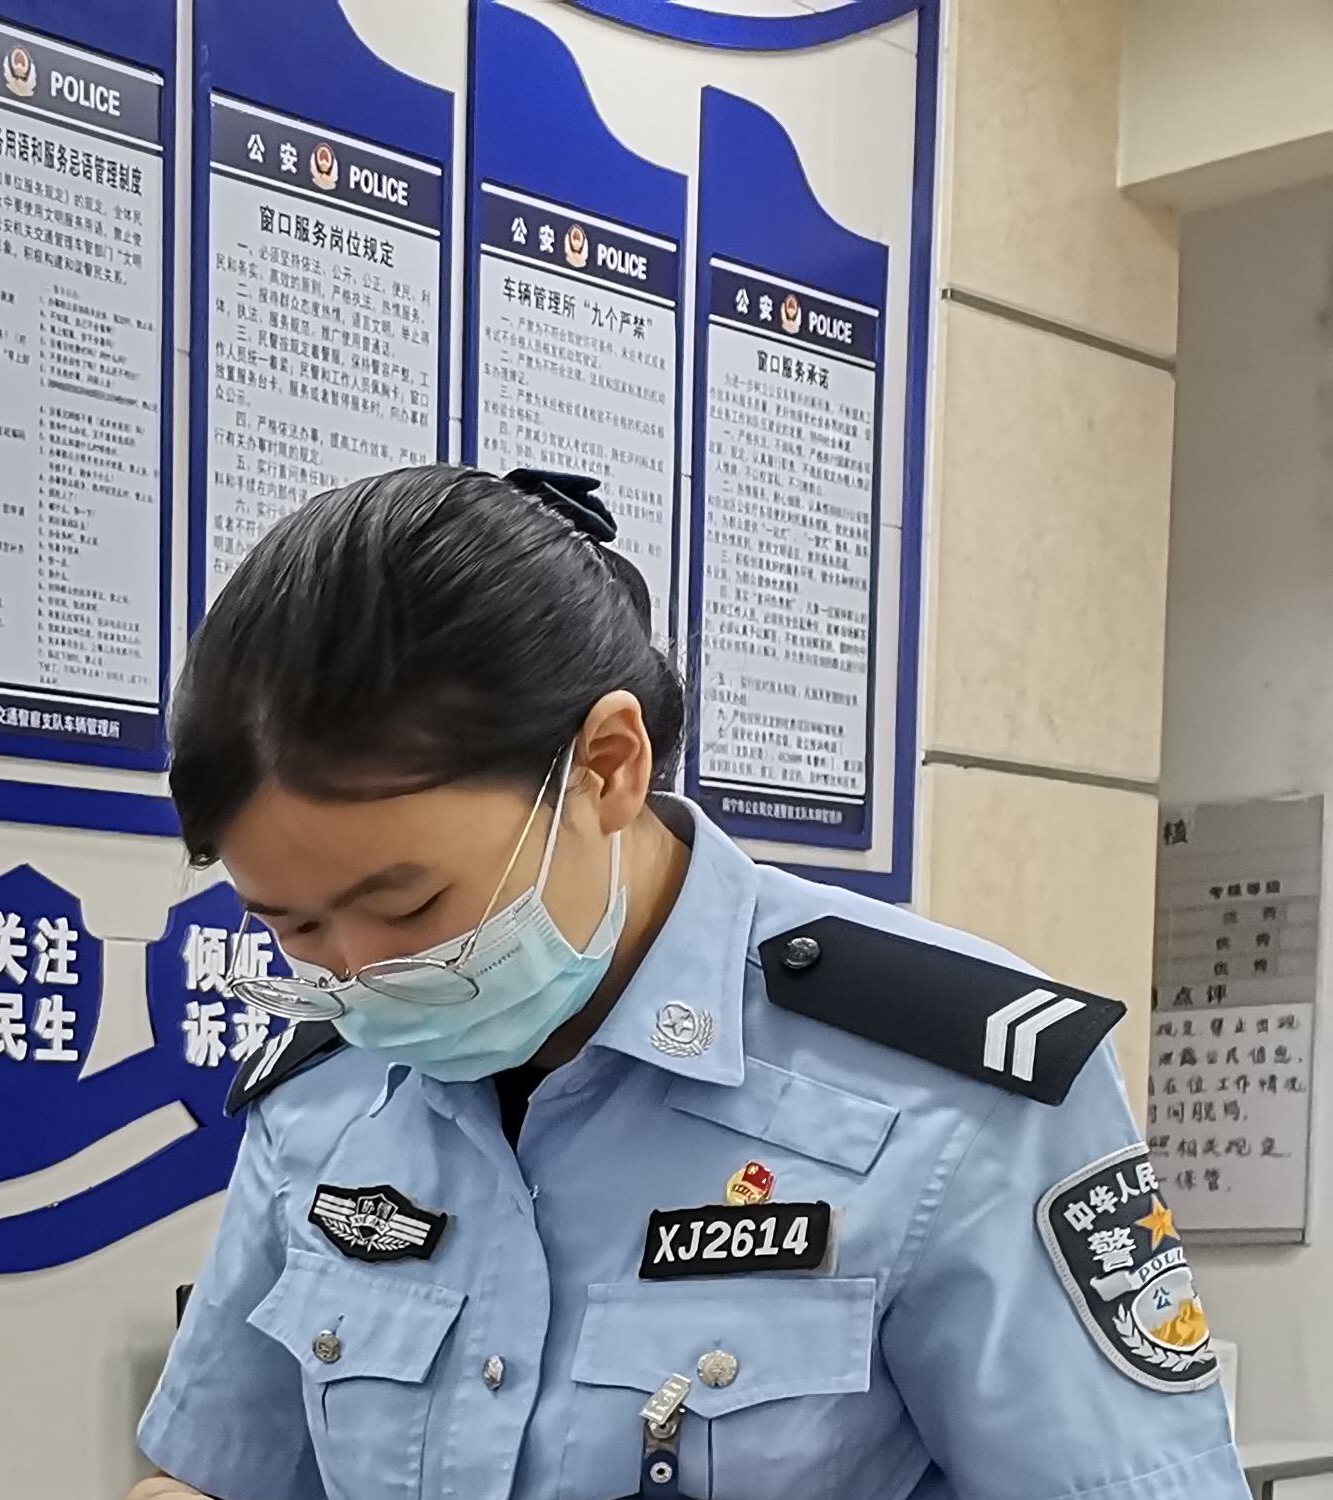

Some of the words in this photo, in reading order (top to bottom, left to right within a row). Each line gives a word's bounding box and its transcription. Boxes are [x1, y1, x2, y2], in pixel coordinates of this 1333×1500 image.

[50, 70, 120, 116] POLICE
[247, 134, 297, 174] 公安
[349, 165, 409, 206] POLICE
[259, 206, 395, 268] 窗口服务岗位规定
[510, 217, 555, 254] 公安
[597, 244, 647, 280] POLICE
[735, 288, 773, 322] 公安
[808, 310, 852, 344] POLICE
[182, 923, 274, 992] 倾听
[654, 1216, 809, 1264] XJ2614
[1087, 1227, 1136, 1273] 警
